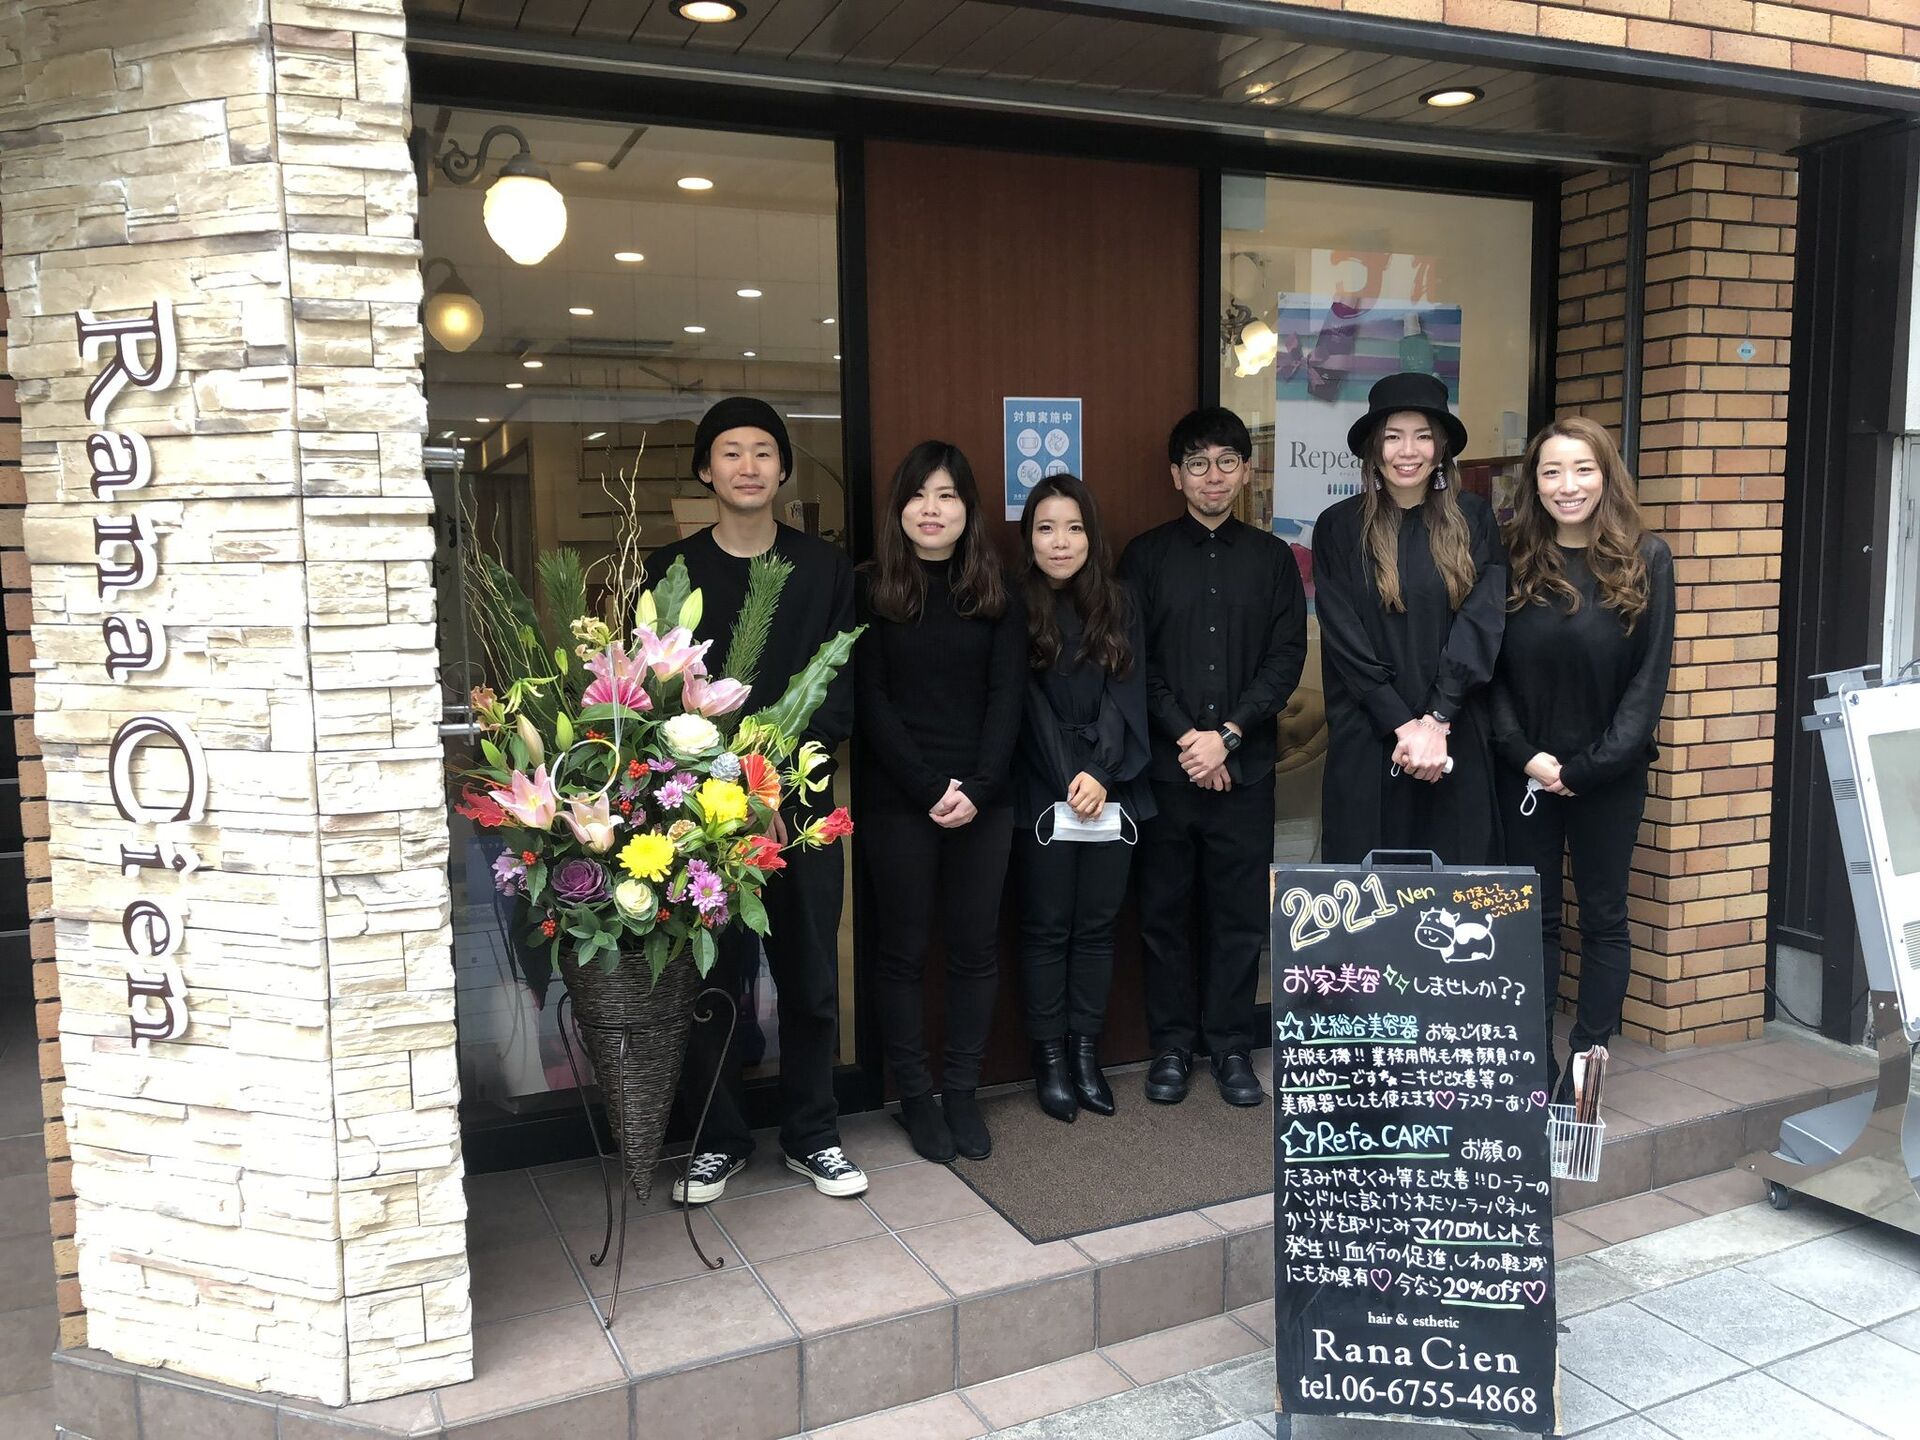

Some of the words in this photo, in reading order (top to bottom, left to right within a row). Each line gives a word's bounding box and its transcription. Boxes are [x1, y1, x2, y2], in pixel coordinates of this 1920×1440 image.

[1013, 411, 1073, 424] 対策実施中
[75, 301, 172, 678] Rana
[109, 716, 203, 1048] Cien
[1452, 883, 1505, 903] あけまして
[1281, 873, 1397, 951] 2021
[1396, 887, 1436, 908] Nen
[1283, 962, 1380, 996] お家美容
[1310, 1012, 1419, 1040] 光総合美容器
[1425, 1022, 1518, 1043] お家で使える
[1381, 1124, 1453, 1149] CARAT
[1460, 1138, 1522, 1162] お顔の
[1367, 1311, 1393, 1325] hair
[1396, 1313, 1408, 1326] &
[1412, 1315, 1460, 1329] esthetic
[1312, 1328, 1414, 1367] Rana
[1421, 1336, 1520, 1374] Cien
[1299, 1373, 1538, 1415] tel.06-6755-4868
